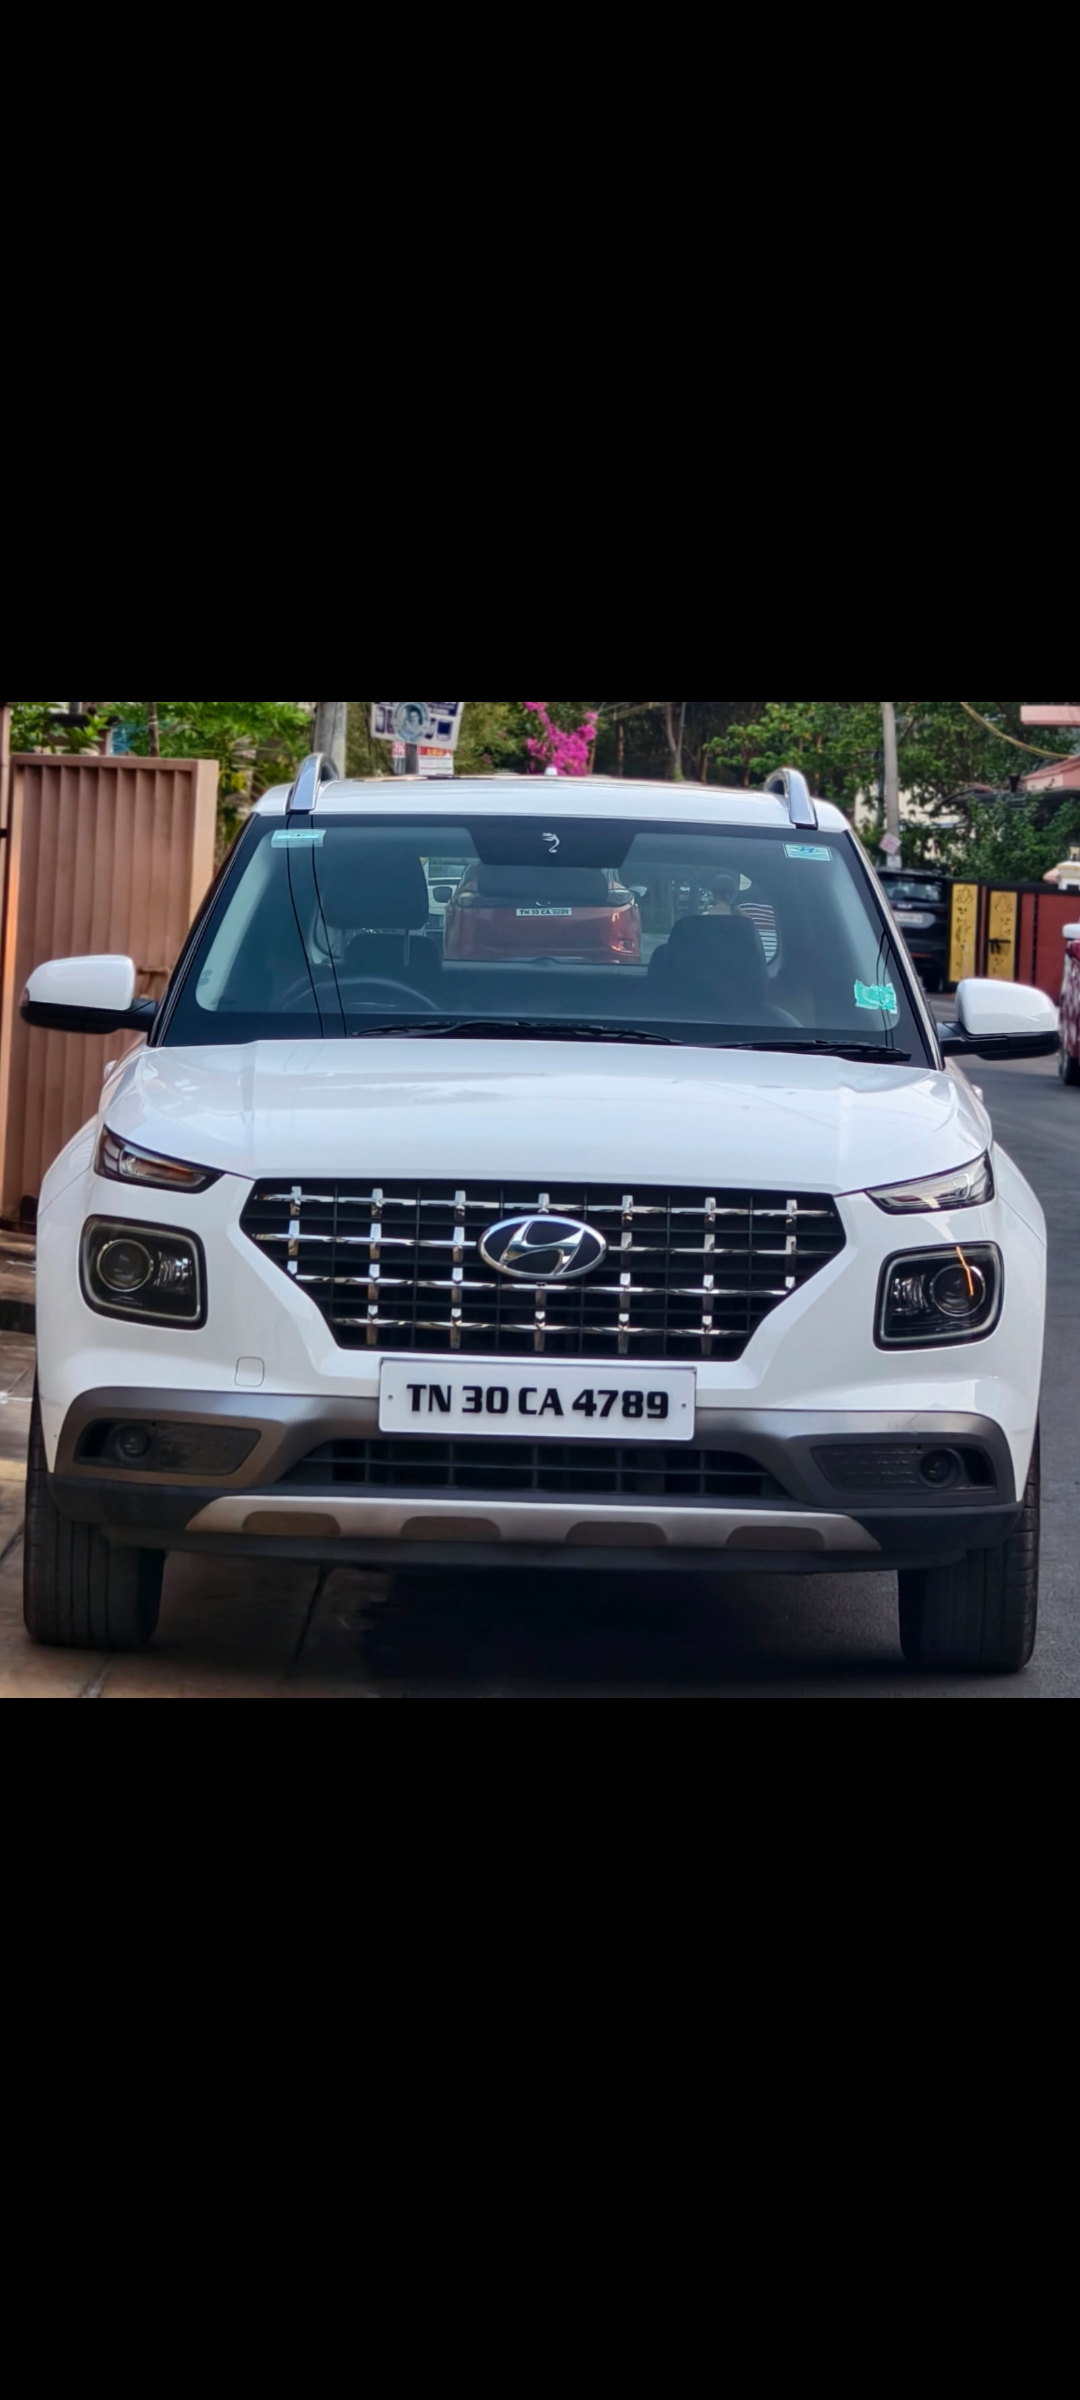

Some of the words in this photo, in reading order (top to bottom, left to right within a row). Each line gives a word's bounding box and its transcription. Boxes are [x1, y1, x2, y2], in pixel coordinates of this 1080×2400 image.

[406, 1383, 452, 1413] TN
[462, 1385, 509, 1414] 30
[518, 1387, 564, 1416] CA
[572, 1389, 669, 1420] 4789
